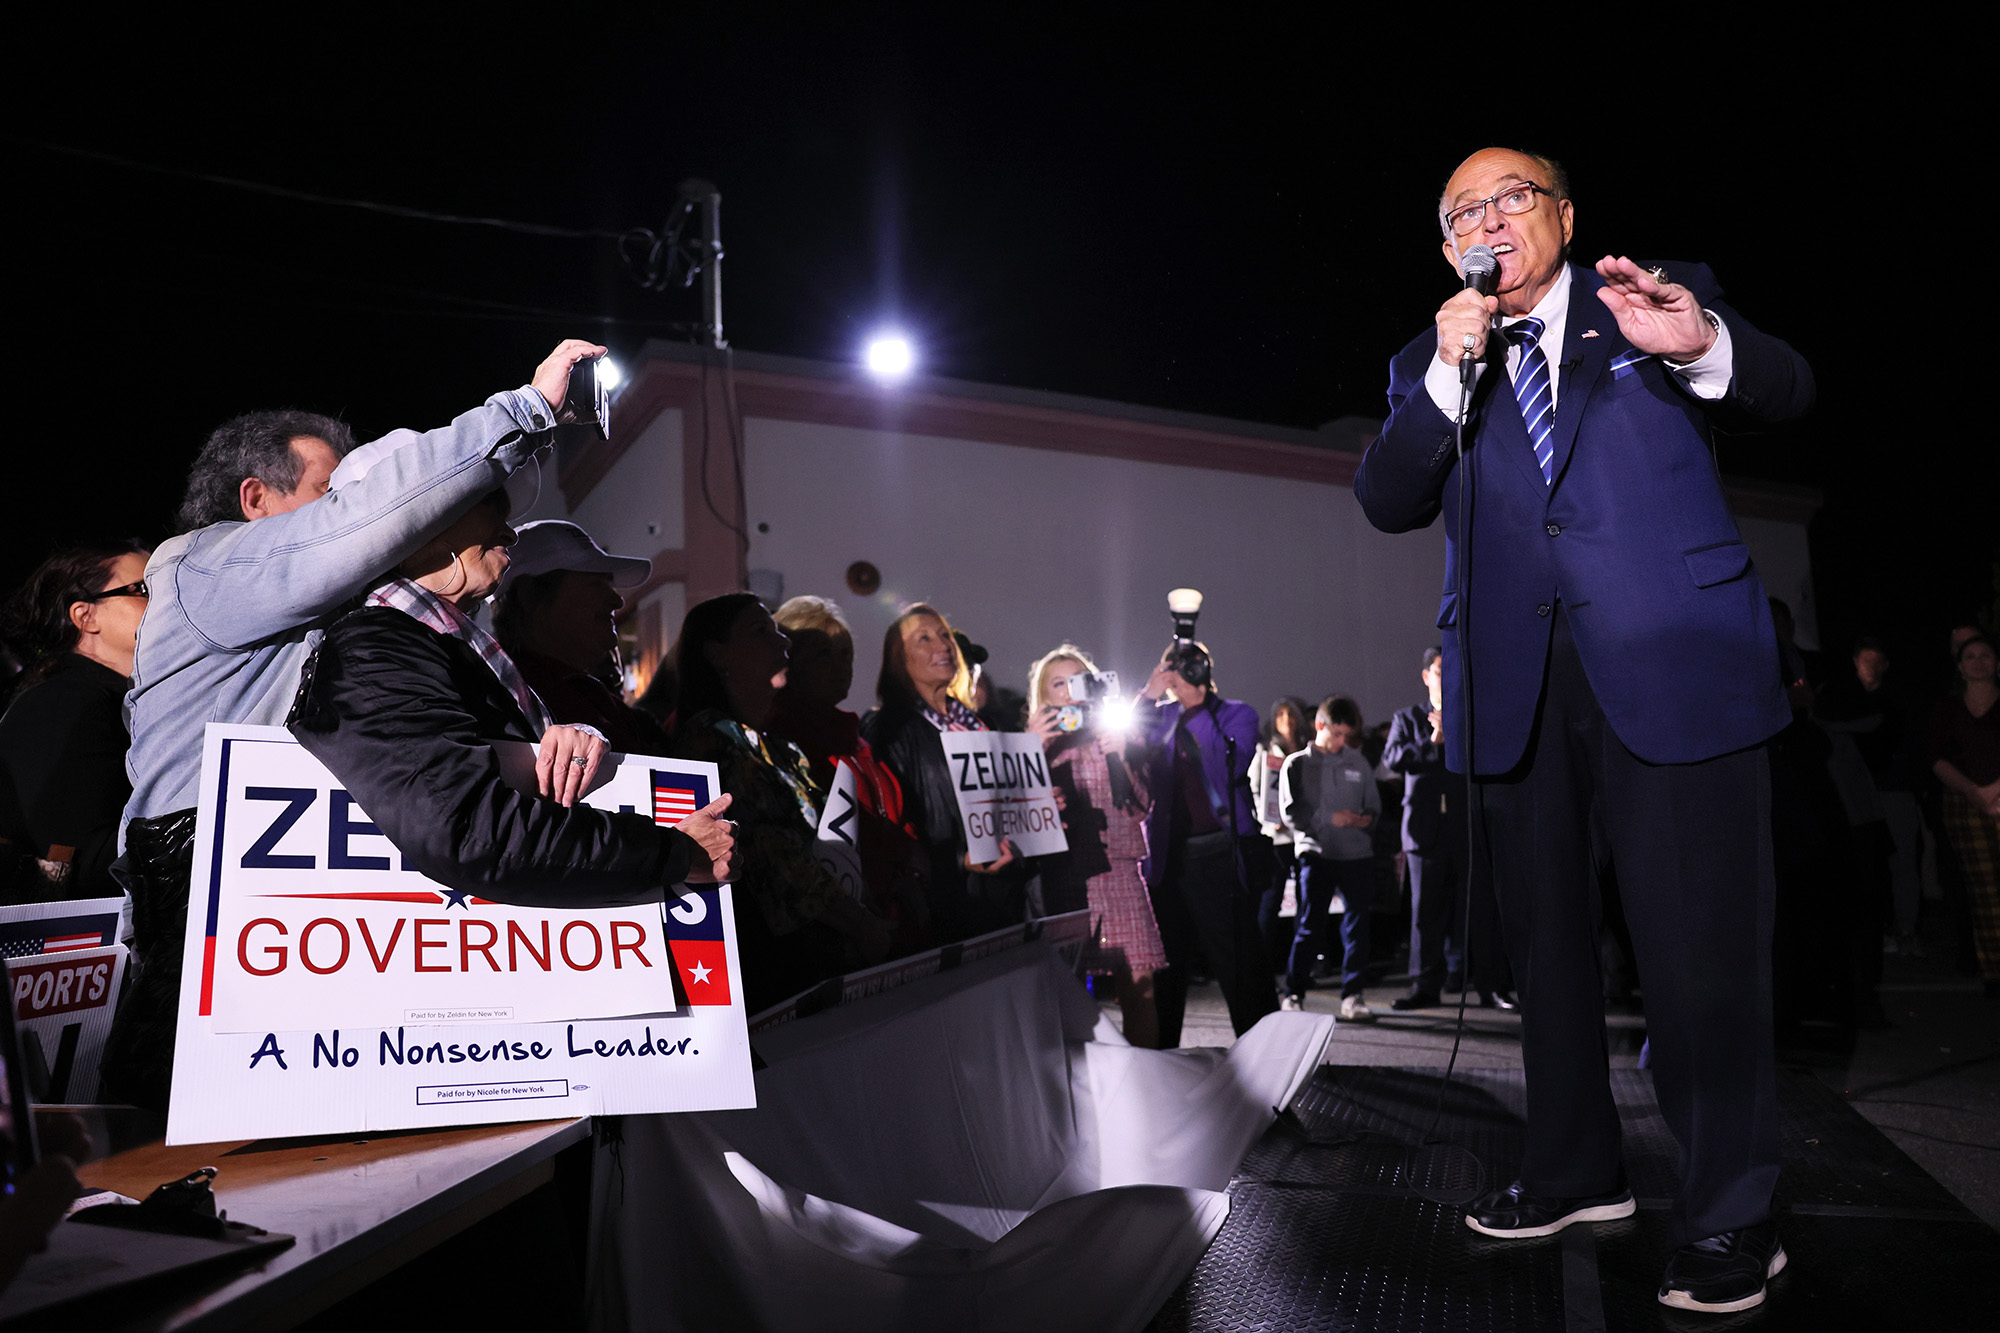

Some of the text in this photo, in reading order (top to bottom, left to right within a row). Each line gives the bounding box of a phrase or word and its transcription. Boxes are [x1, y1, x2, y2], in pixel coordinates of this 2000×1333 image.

[951, 751, 1046, 792] ZELDIN
[968, 807, 1058, 839] GOERNOR
[237, 917, 653, 977] GOVERNOR
[10, 963, 108, 1012] PORTS
[438, 1012, 446, 1020] by
[250, 1025, 700, 1070] A No Nonsense Leader.
[437, 1090, 453, 1098] Paid
[454, 1089, 465, 1097] for
[466, 1089, 476, 1098] by
[477, 1088, 500, 1096] Nicole
[500, 1087, 511, 1095] for
[529, 1085, 545, 1093] York
